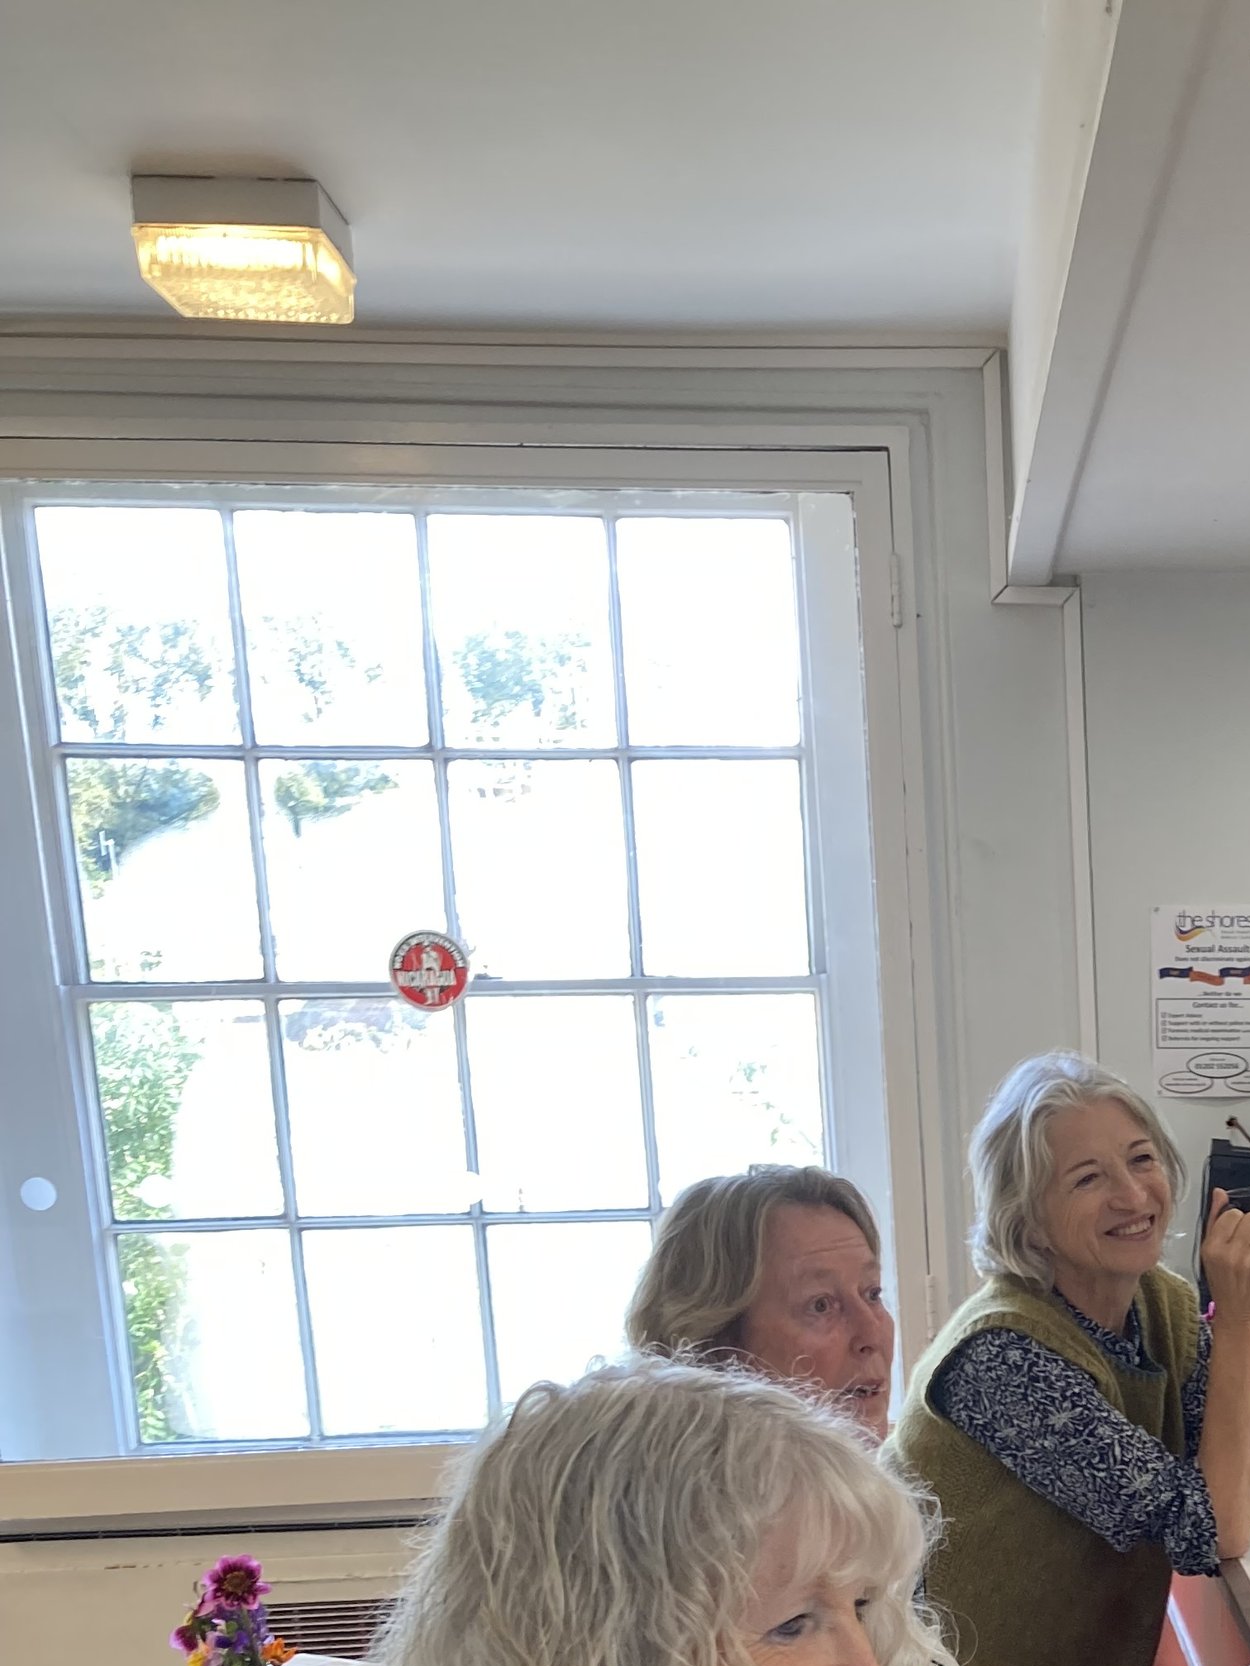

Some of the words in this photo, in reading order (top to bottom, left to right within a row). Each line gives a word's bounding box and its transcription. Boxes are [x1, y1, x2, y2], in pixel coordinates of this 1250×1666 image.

[1176, 909, 1203, 928] the
[1185, 944, 1215, 953] Sexual
[1217, 944, 1250, 953] Assault
